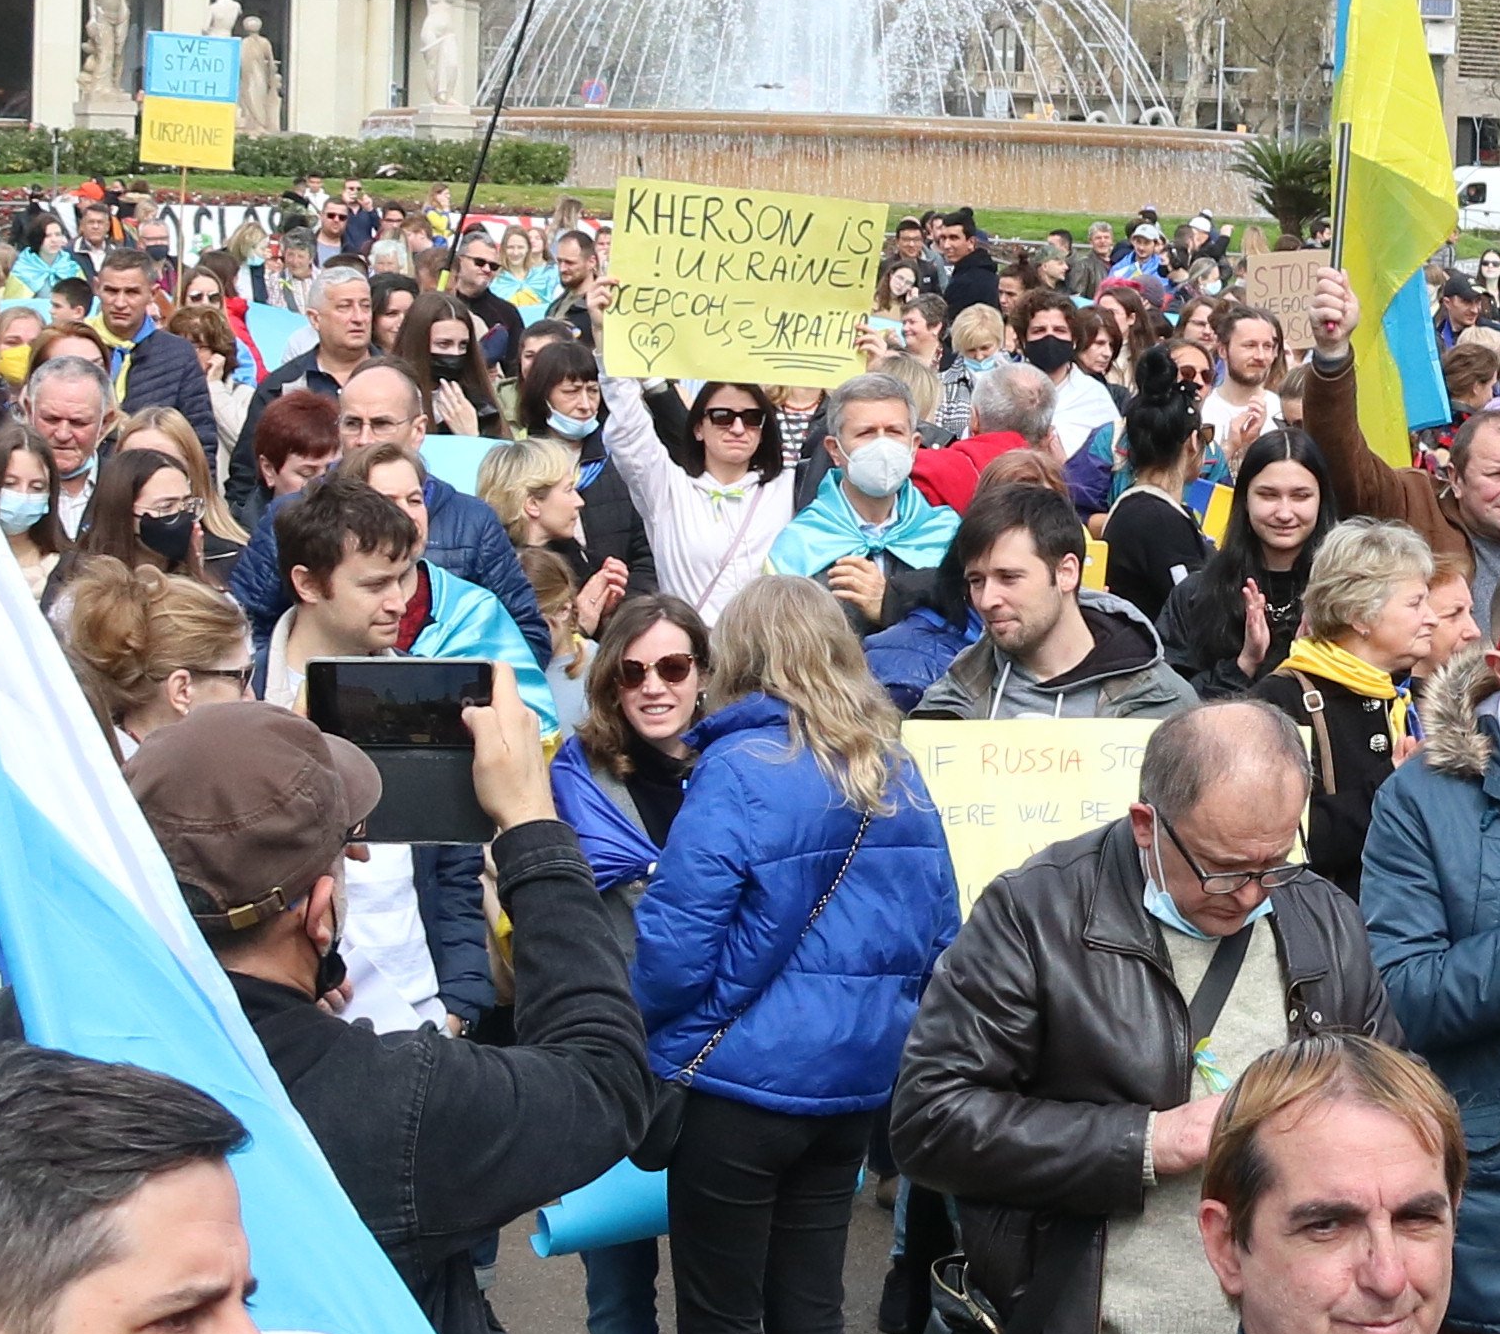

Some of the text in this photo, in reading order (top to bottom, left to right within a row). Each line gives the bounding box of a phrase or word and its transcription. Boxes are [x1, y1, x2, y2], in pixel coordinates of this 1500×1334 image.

[177, 39, 210, 56] WE
[164, 54, 225, 74] STAND
[166, 79, 217, 96] WITH
[150, 120, 223, 147] UKRAINE
[625, 187, 814, 248] KHERSON
[1254, 261, 1320, 298] STOP
[606, 283, 728, 318] ХЕРСОН
[927, 743, 1146, 778] IF RUSSIA STO
[1018, 801, 1063, 823] WILL
[1081, 800, 1113, 823] BE
